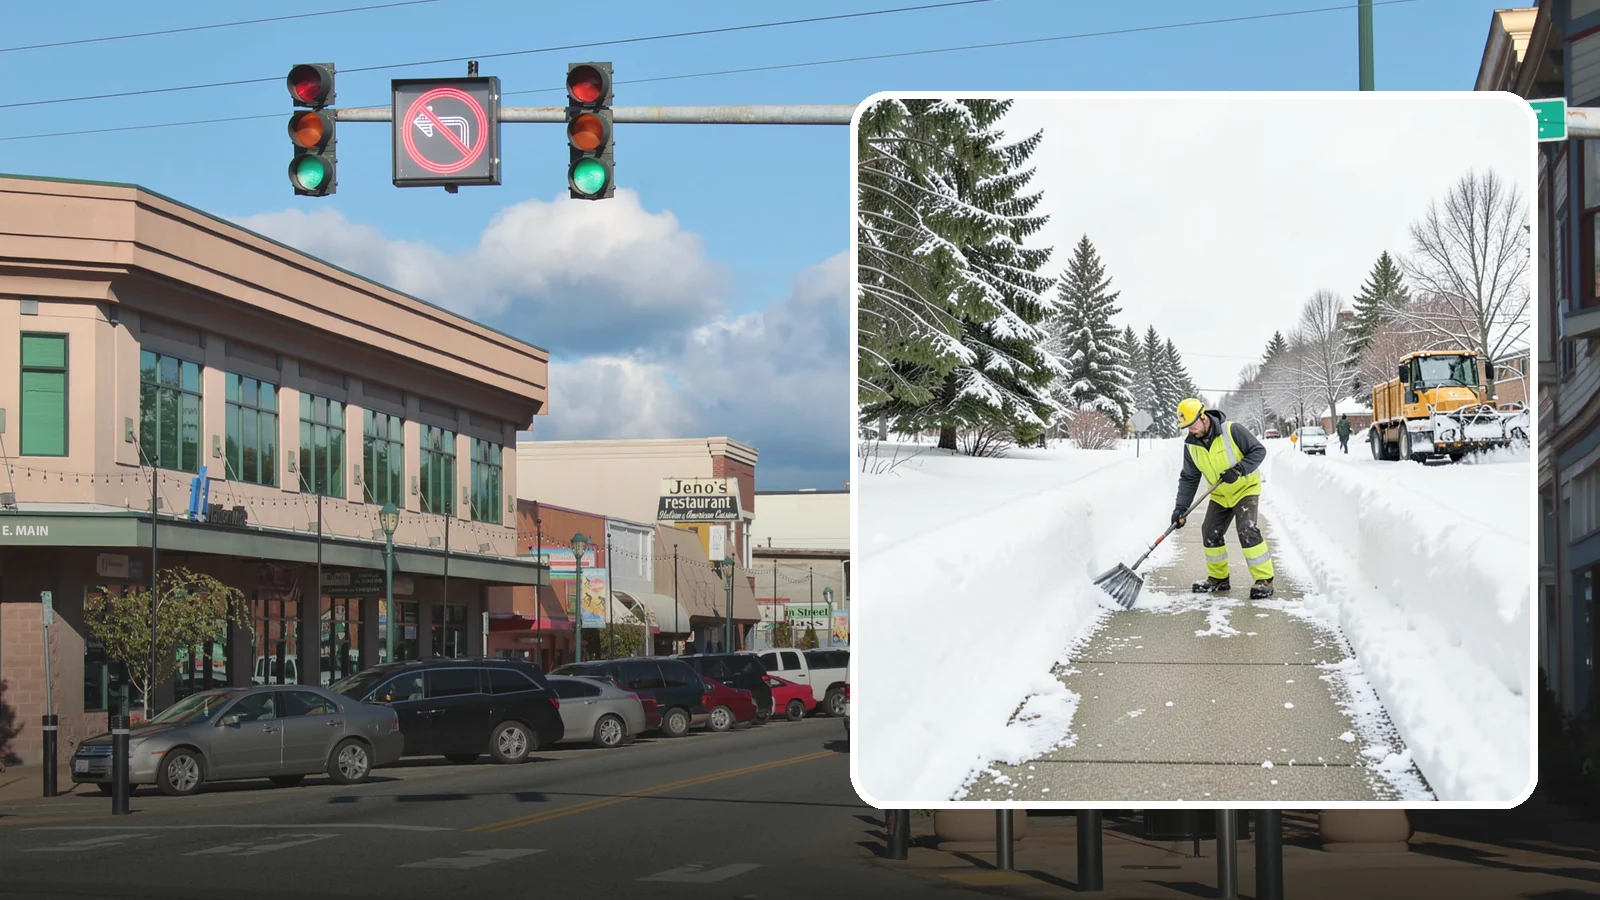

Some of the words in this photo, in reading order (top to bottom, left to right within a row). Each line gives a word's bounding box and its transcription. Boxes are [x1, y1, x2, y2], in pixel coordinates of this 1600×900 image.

[670, 480, 727, 494] Jeno's
[665, 496, 730, 508] restaurant
[686, 510, 714, 519] American
[715, 509, 737, 519] Cuisine
[2, 525, 13, 536] E.
[15, 525, 49, 536] MAIN
[797, 607, 828, 617] Street
